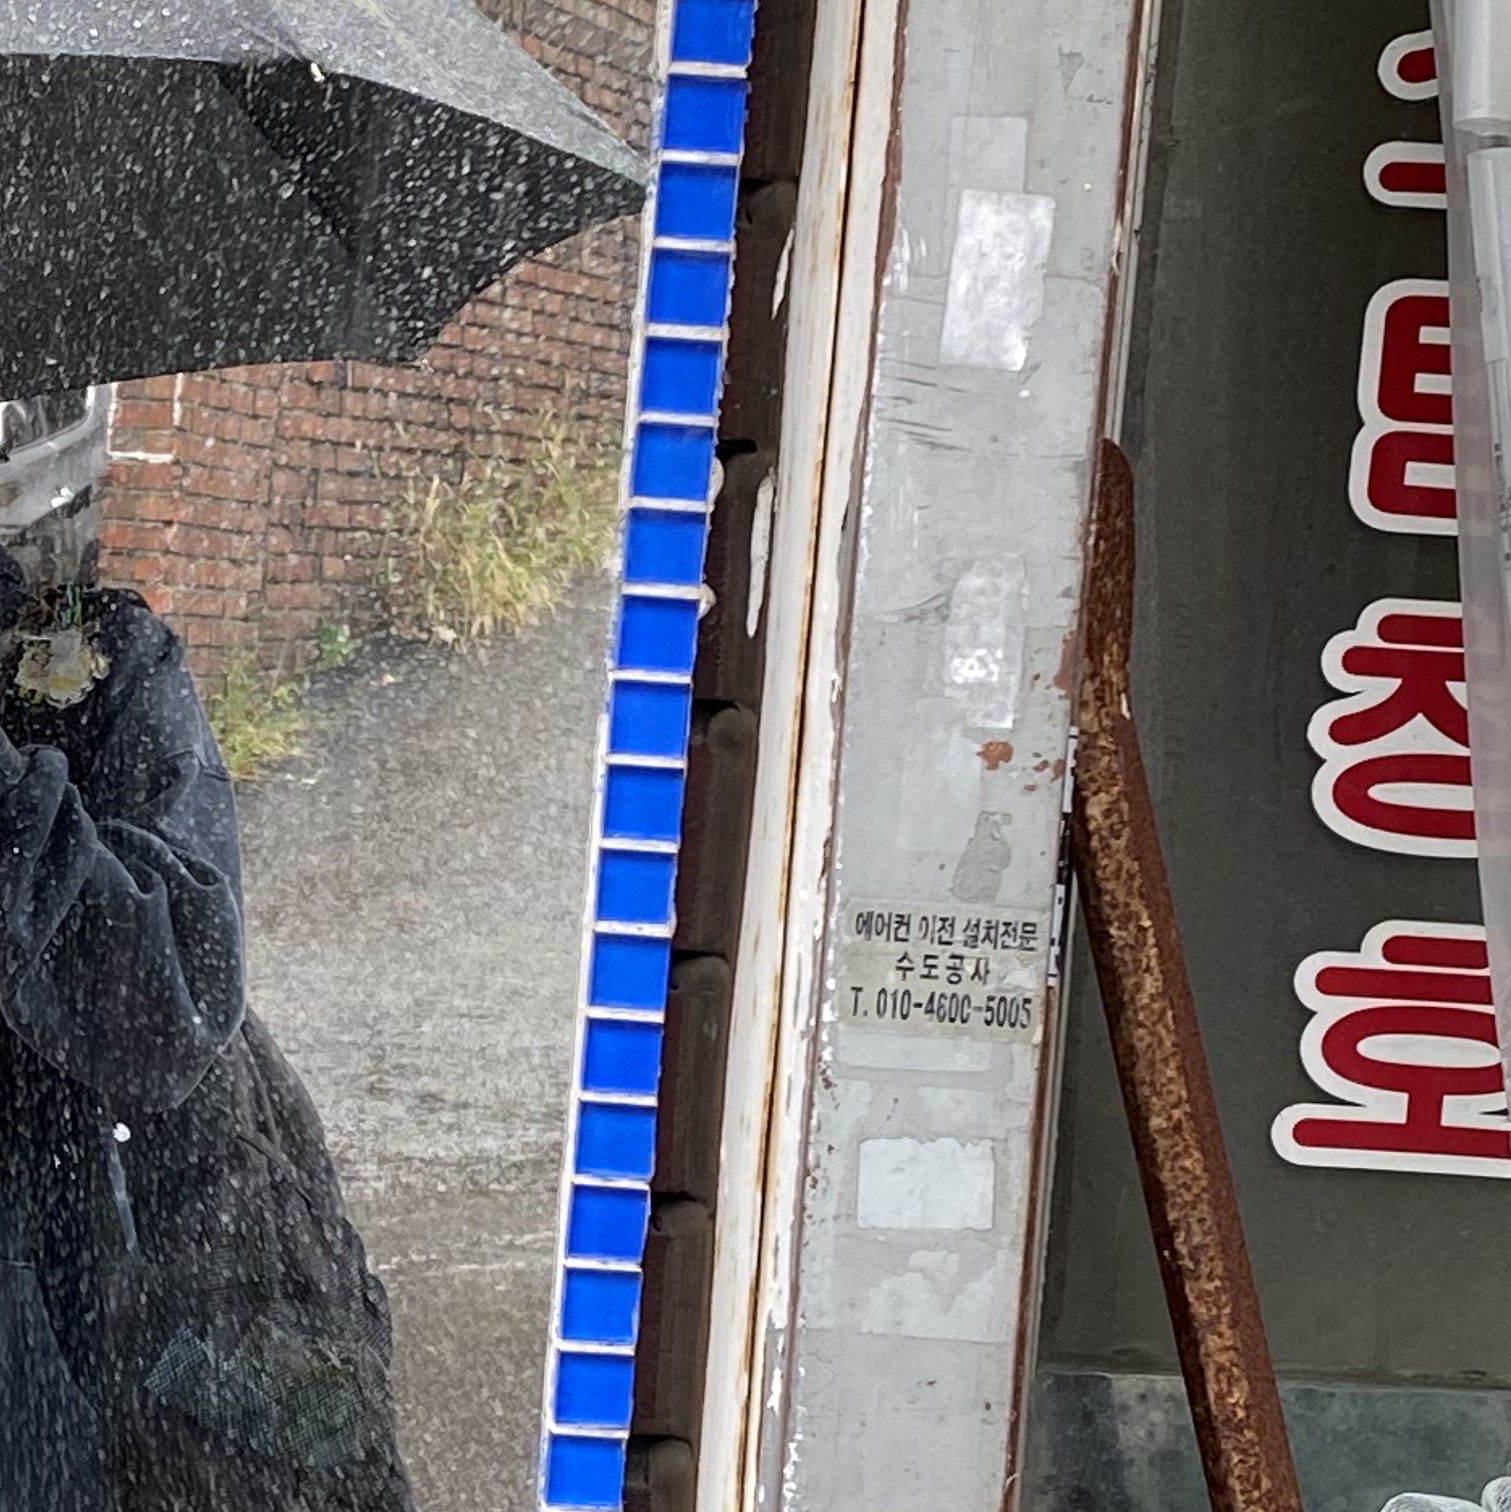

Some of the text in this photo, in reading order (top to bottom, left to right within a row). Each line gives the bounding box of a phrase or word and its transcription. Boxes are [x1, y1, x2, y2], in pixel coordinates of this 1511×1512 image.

[855, 911, 1039, 951] 에어컨 이전 설치전문
